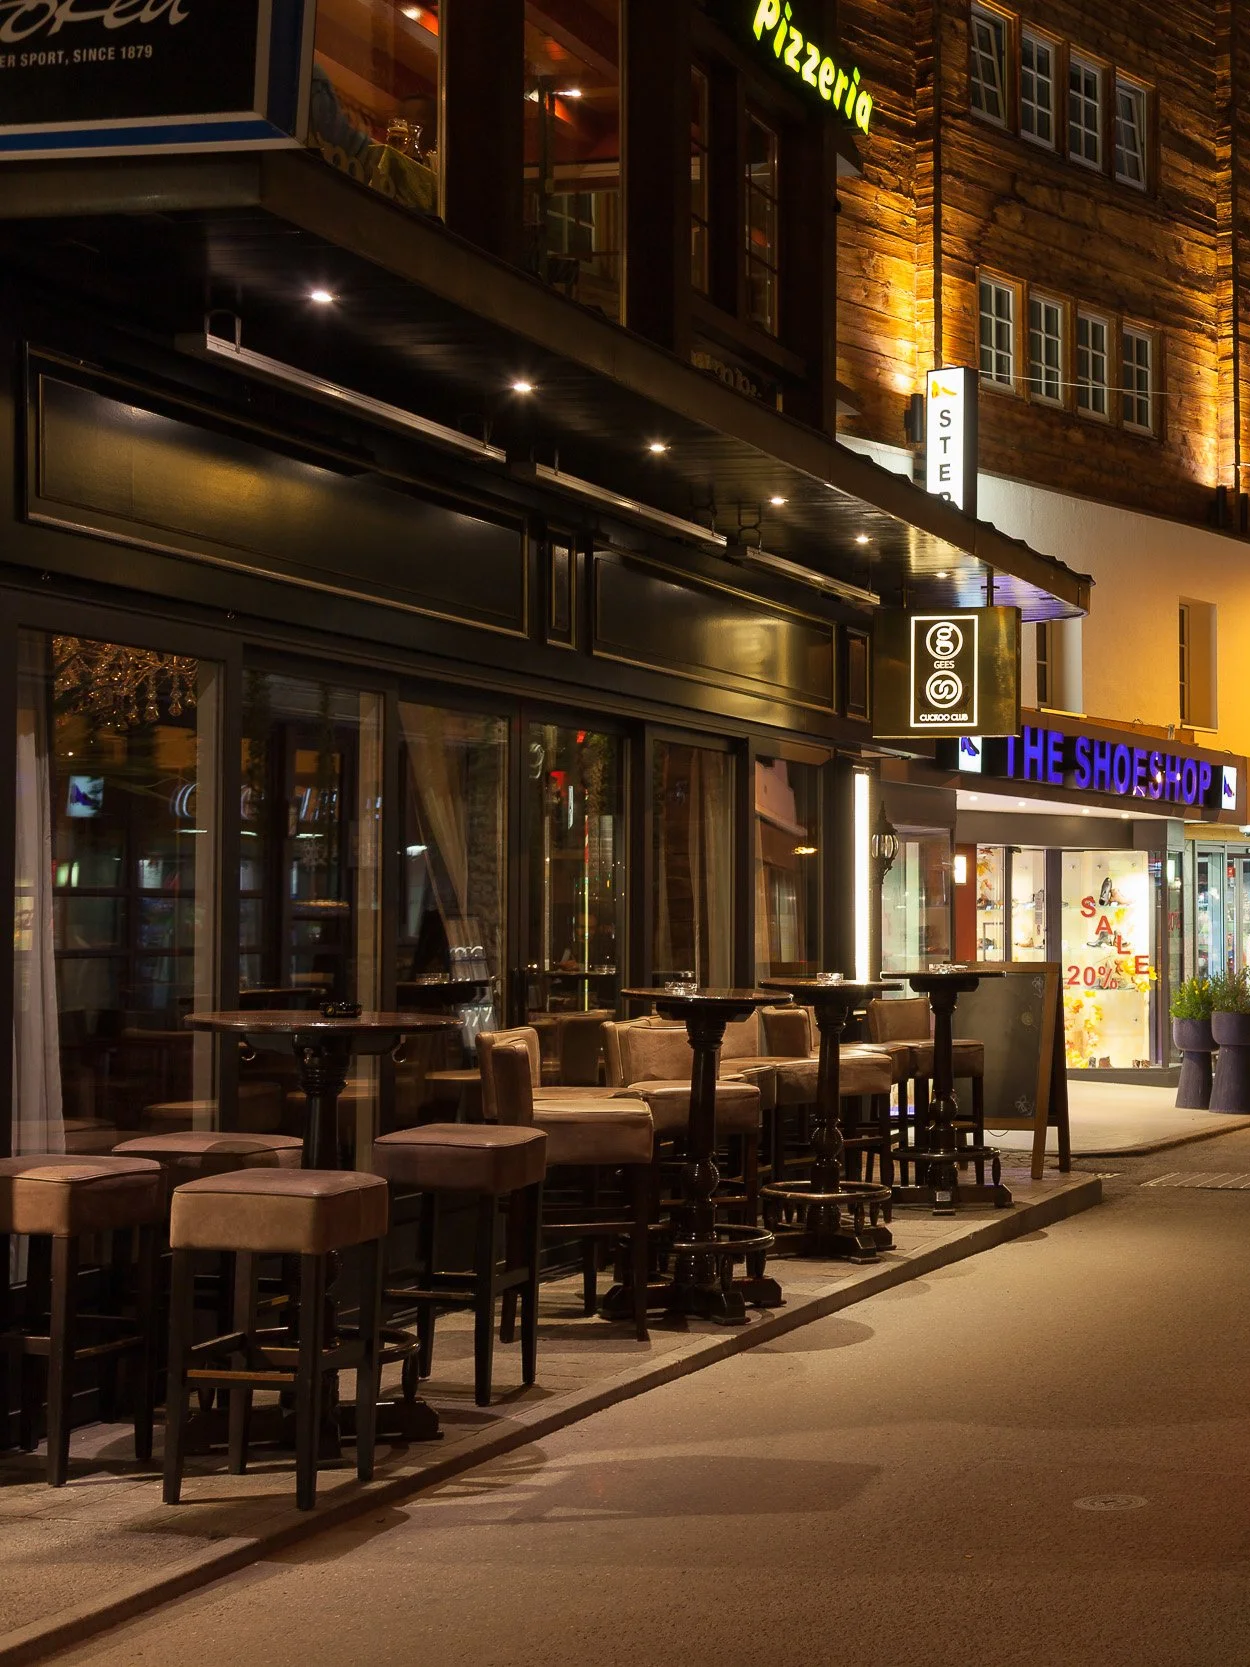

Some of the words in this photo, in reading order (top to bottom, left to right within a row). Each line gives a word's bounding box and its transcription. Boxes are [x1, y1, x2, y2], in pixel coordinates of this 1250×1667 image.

[20, 51, 69, 67] SPORT,
[73, 47, 115, 63] SINCE
[120, 44, 153, 60] 1879
[753, 0, 873, 135] Pizzeria
[933, 660, 955, 669] GEES
[919, 713, 951, 722] CUCKOO
[950, 713, 969, 722] CLUB
[1074, 735, 1212, 807] SHOESHOP
[1080, 895, 1149, 974] SALE
[1066, 965, 1118, 990] 20%
